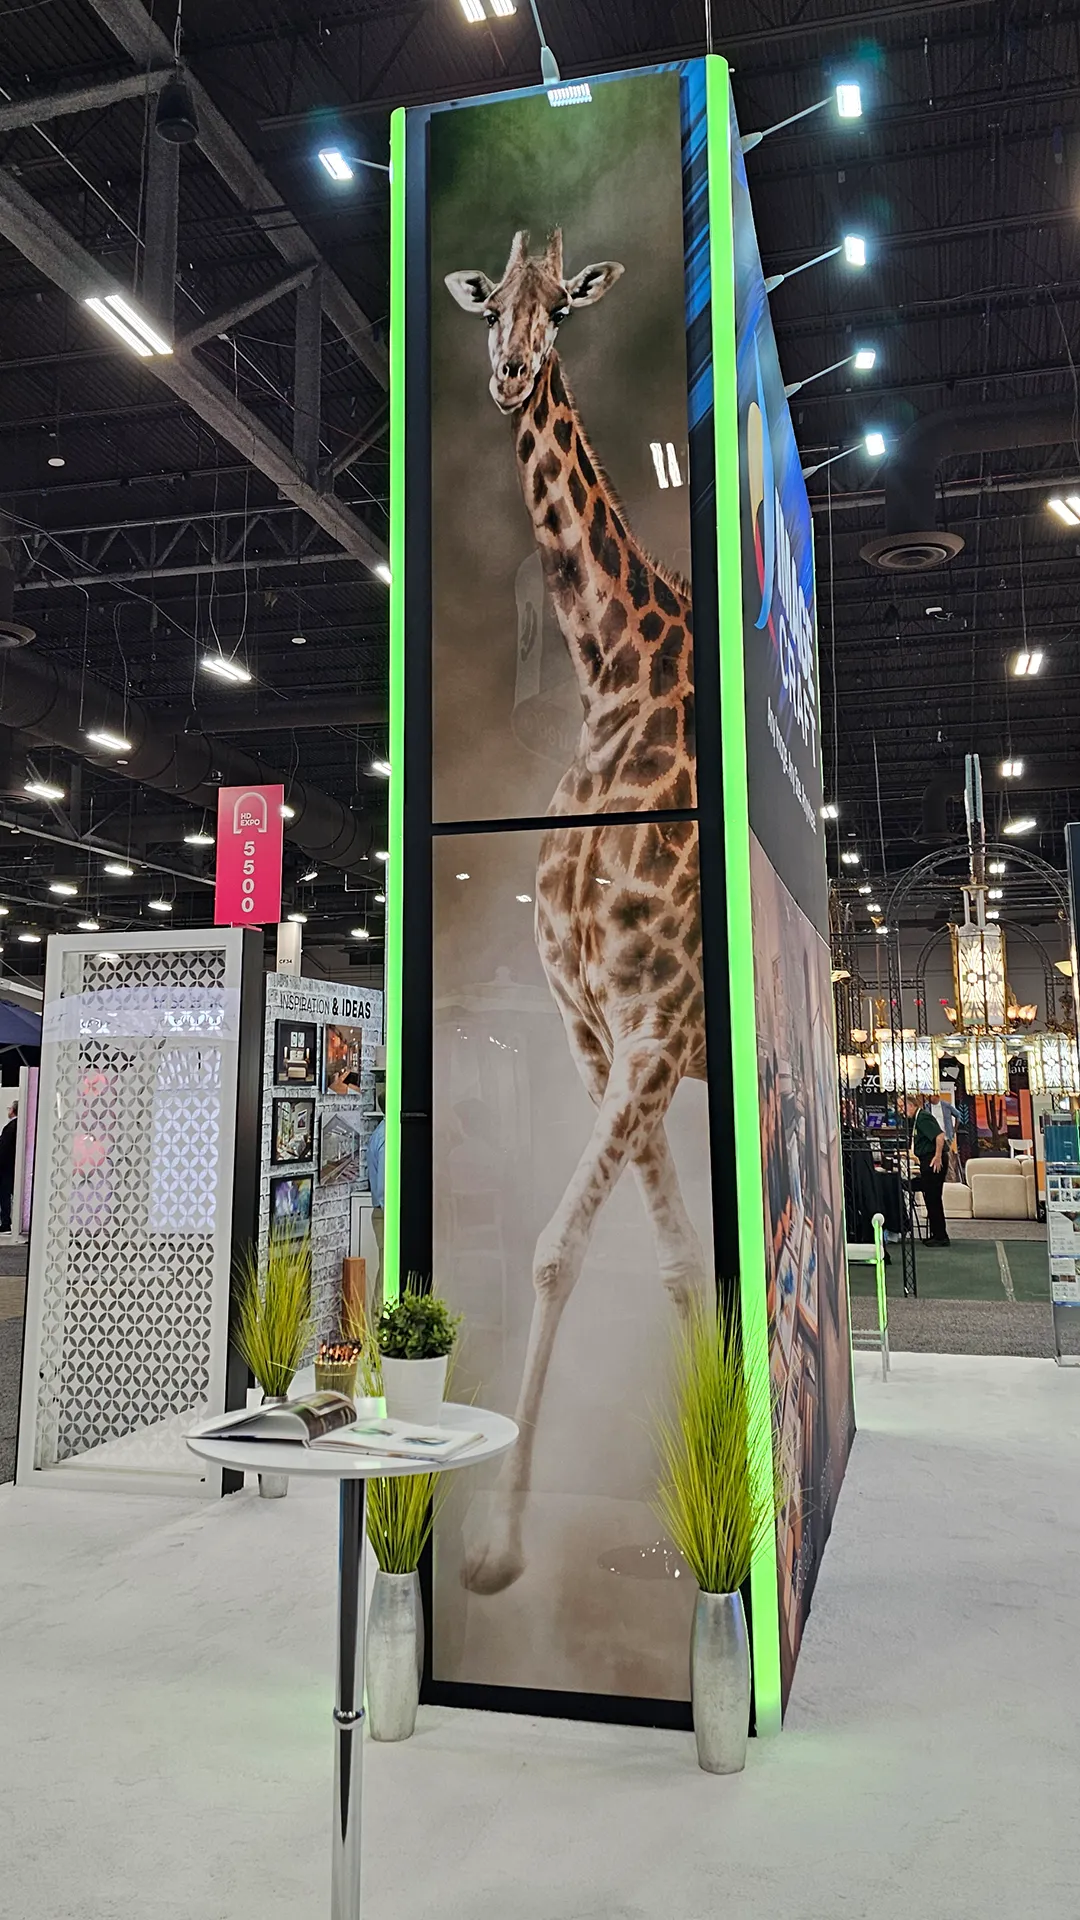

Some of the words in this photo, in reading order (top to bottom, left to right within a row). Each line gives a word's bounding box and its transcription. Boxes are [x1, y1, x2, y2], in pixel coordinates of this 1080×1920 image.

[775, 486, 815, 706] IMAGE
[779, 613, 816, 768] CRAFT
[240, 812, 252, 820] HD
[240, 818, 260, 826] EXPO
[241, 841, 255, 913] 5500
[281, 993, 330, 1015] INSPIRATION
[332, 997, 339, 1015] &
[342, 998, 371, 1019] IDEAS
